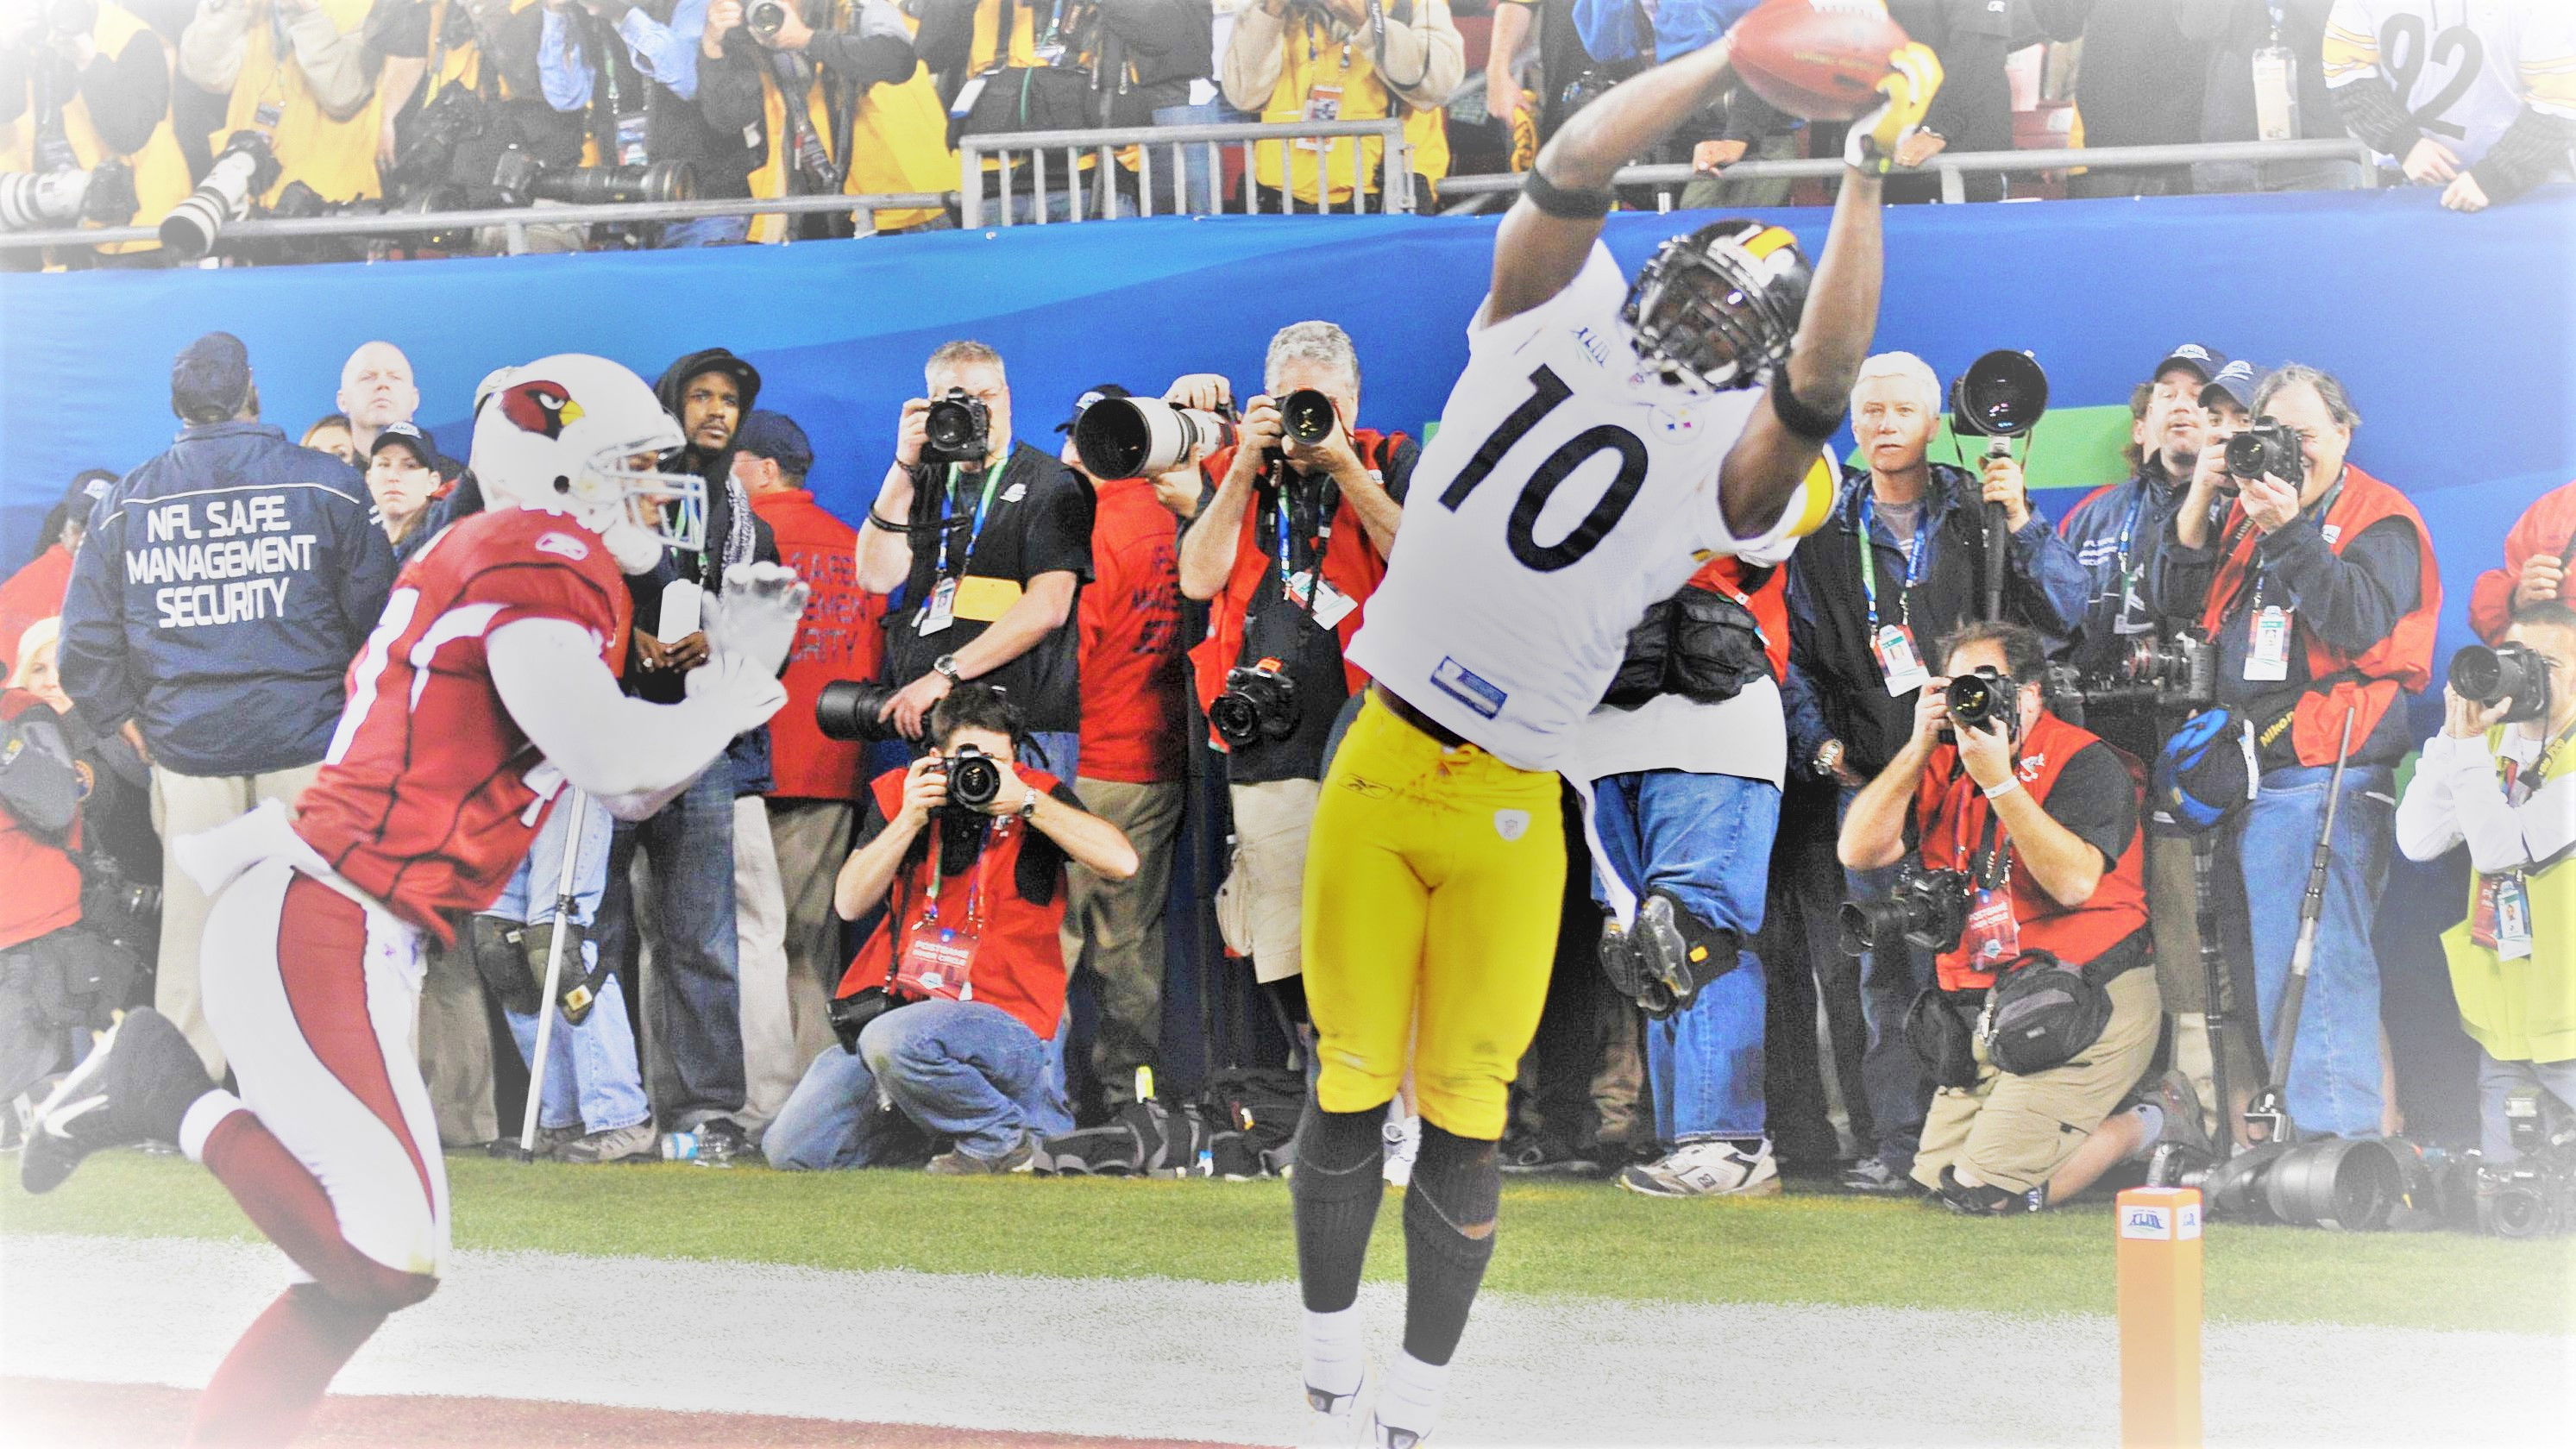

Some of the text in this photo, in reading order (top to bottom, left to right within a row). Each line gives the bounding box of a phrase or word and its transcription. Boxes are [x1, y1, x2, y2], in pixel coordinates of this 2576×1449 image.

[2380, 12, 2483, 141] 92
[1437, 362, 1649, 573] 10
[148, 504, 202, 543] NFL
[126, 535, 317, 584] MANAGEMENT
[156, 577, 290, 628] SECURITY
